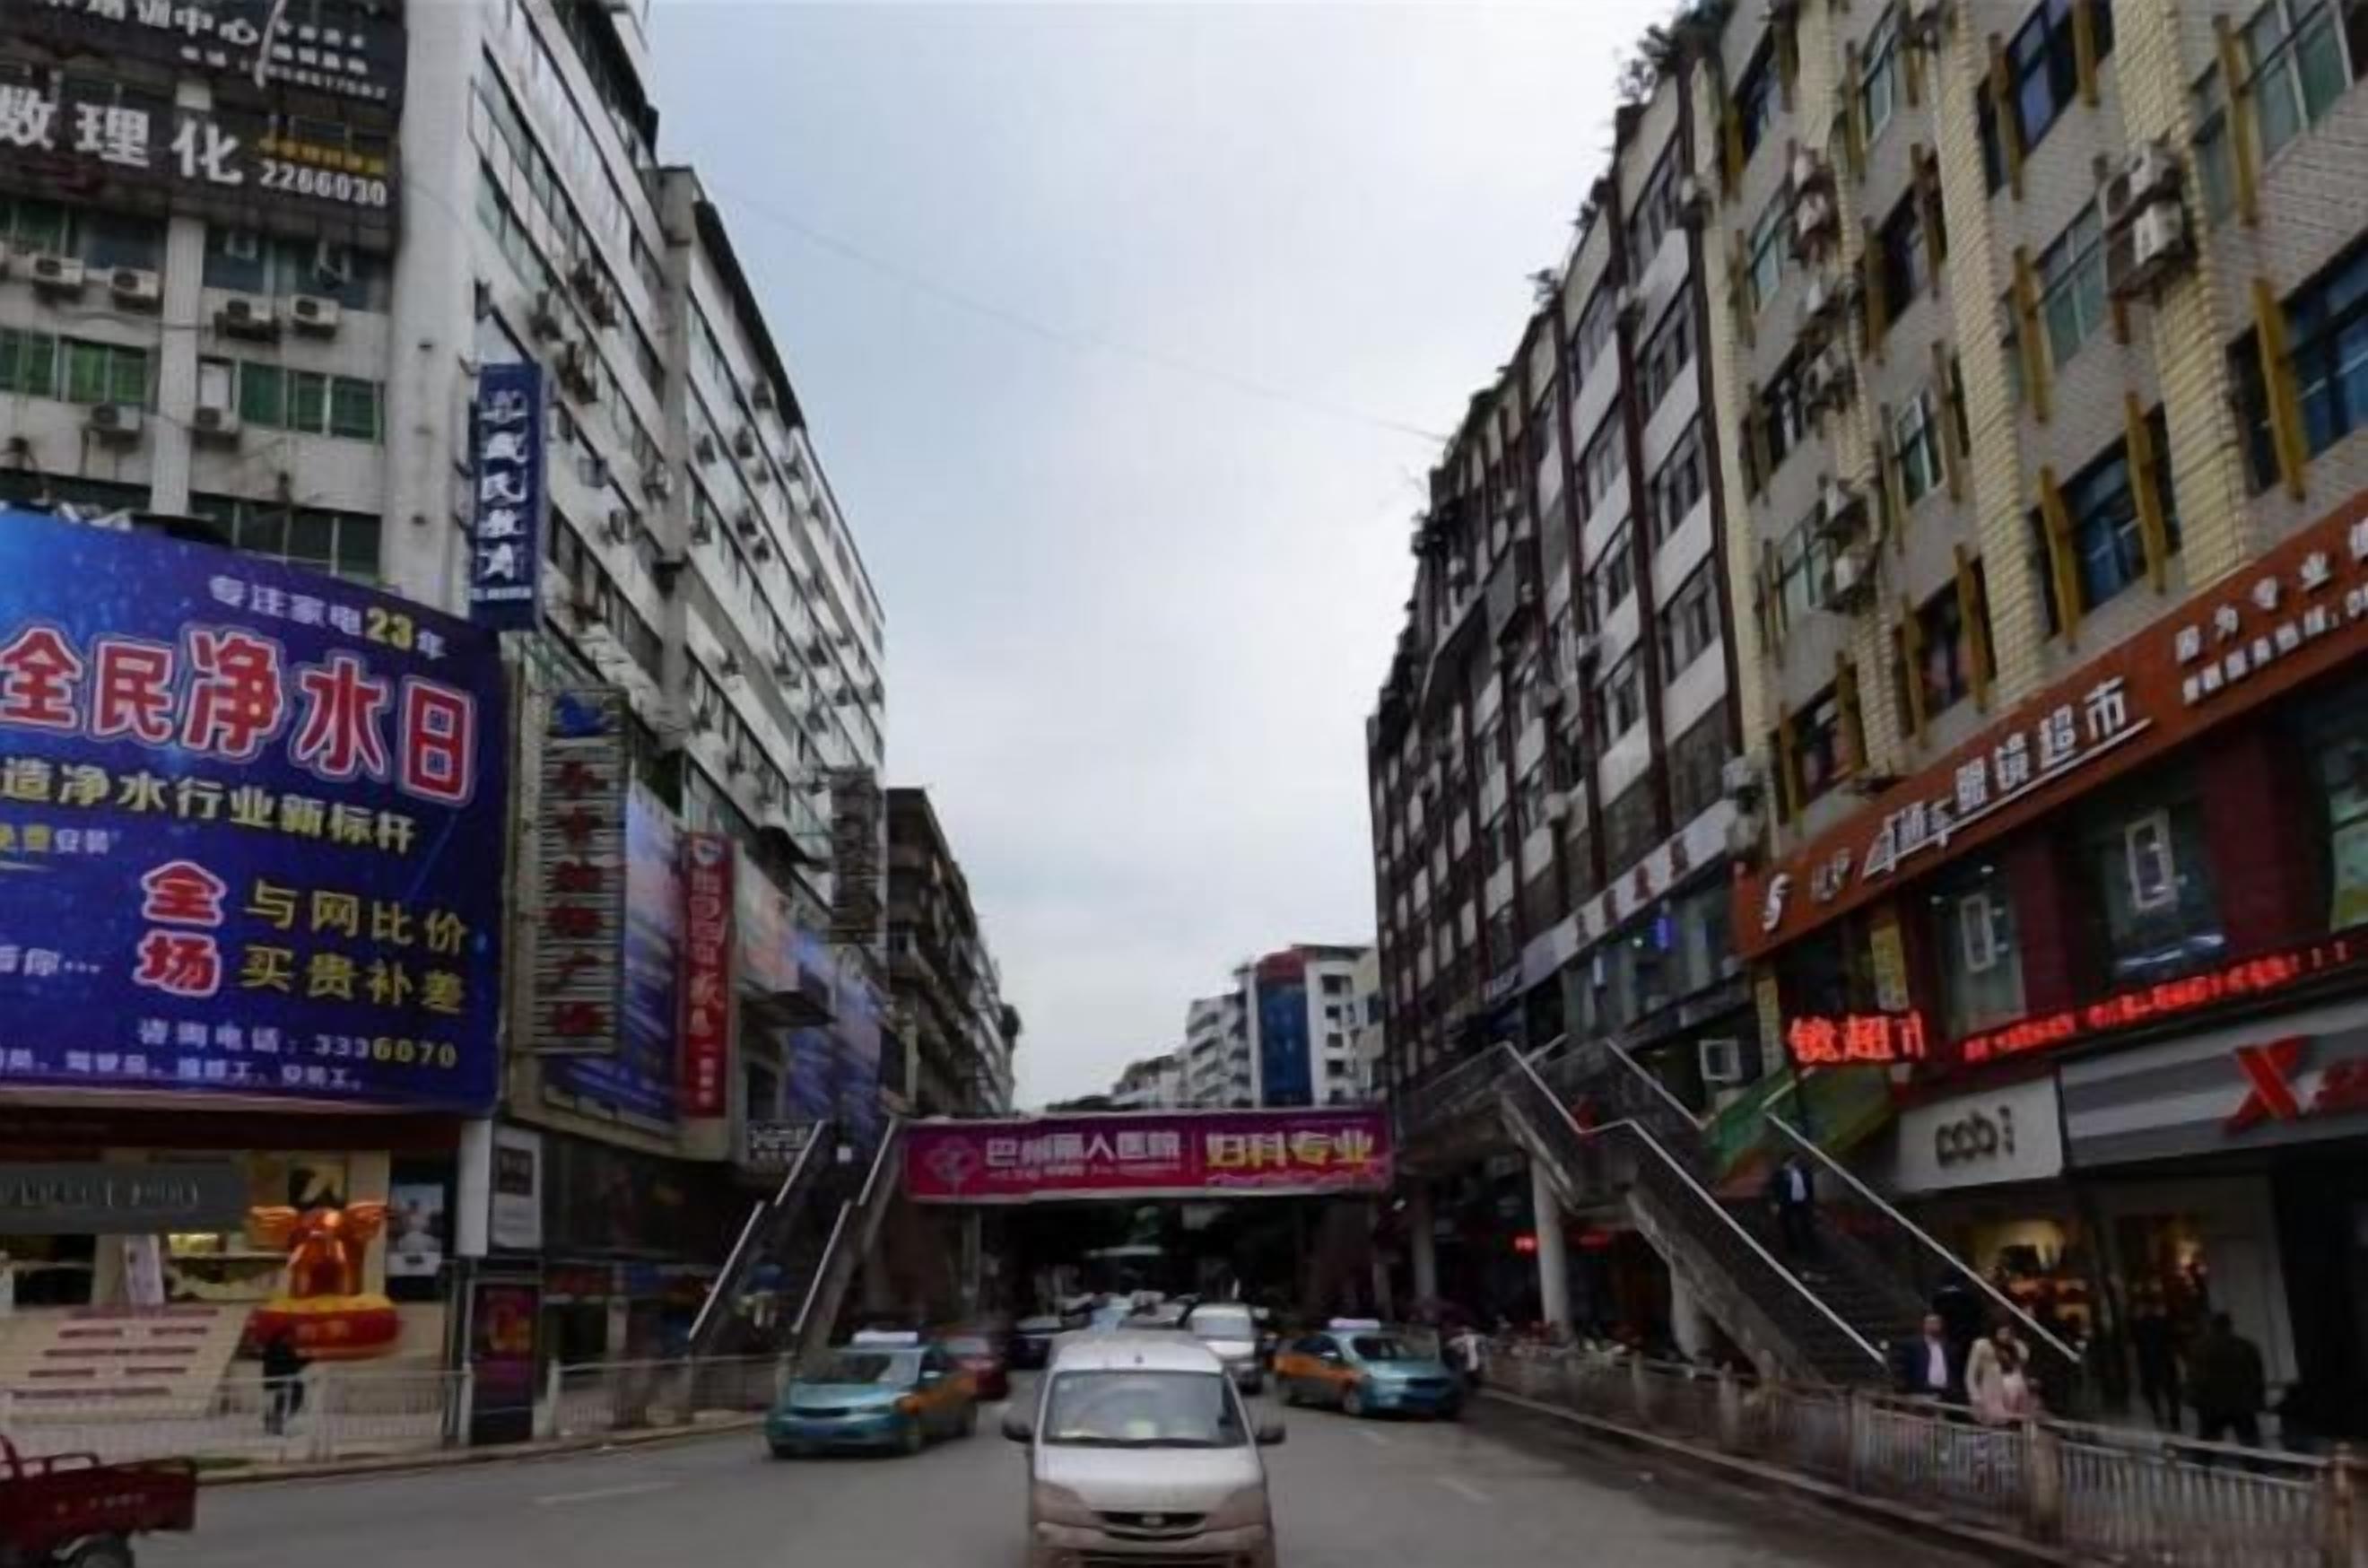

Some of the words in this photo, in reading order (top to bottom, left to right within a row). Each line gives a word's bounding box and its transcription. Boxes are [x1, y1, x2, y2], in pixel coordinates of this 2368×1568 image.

[0, 84, 243, 184] 数理化
[0, 625, 475, 803] 全民净水日
[134, 859, 227, 997] 全场
[244, 879, 468, 957] 与网比价
[241, 943, 465, 1015] 买贵补差
